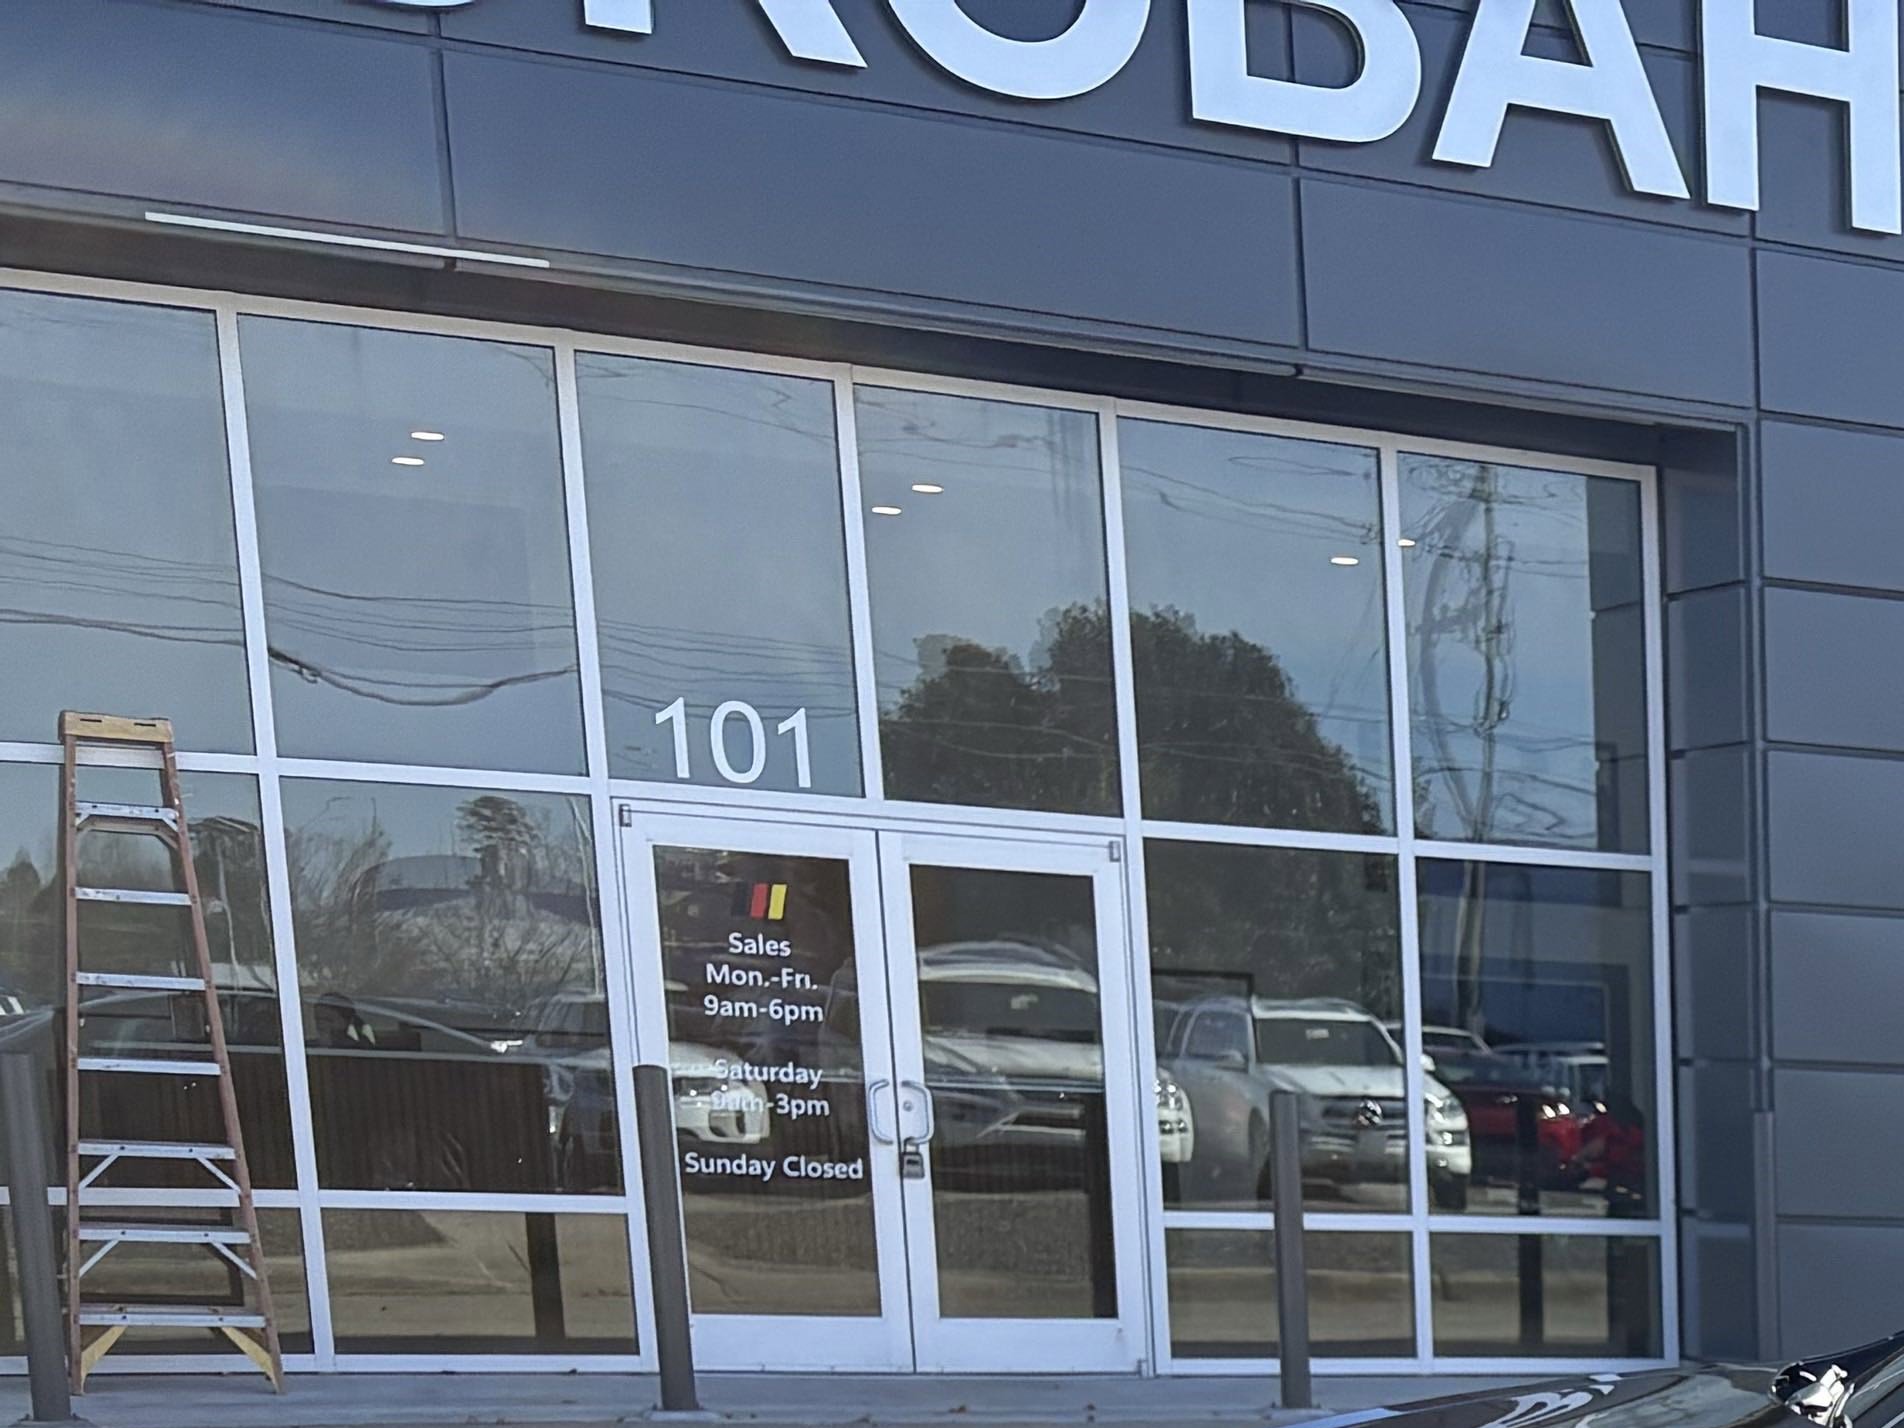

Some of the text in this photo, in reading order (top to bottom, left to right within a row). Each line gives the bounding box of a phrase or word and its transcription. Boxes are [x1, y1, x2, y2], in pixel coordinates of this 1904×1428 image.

[655, 697, 811, 788] 101
[728, 932, 792, 957] Sales
[705, 963, 819, 991] Mon.-Fri.
[703, 994, 824, 1026] 9am-6pm
[714, 1059, 823, 1090] Saturday
[685, 1152, 864, 1181] Sunday Closed
